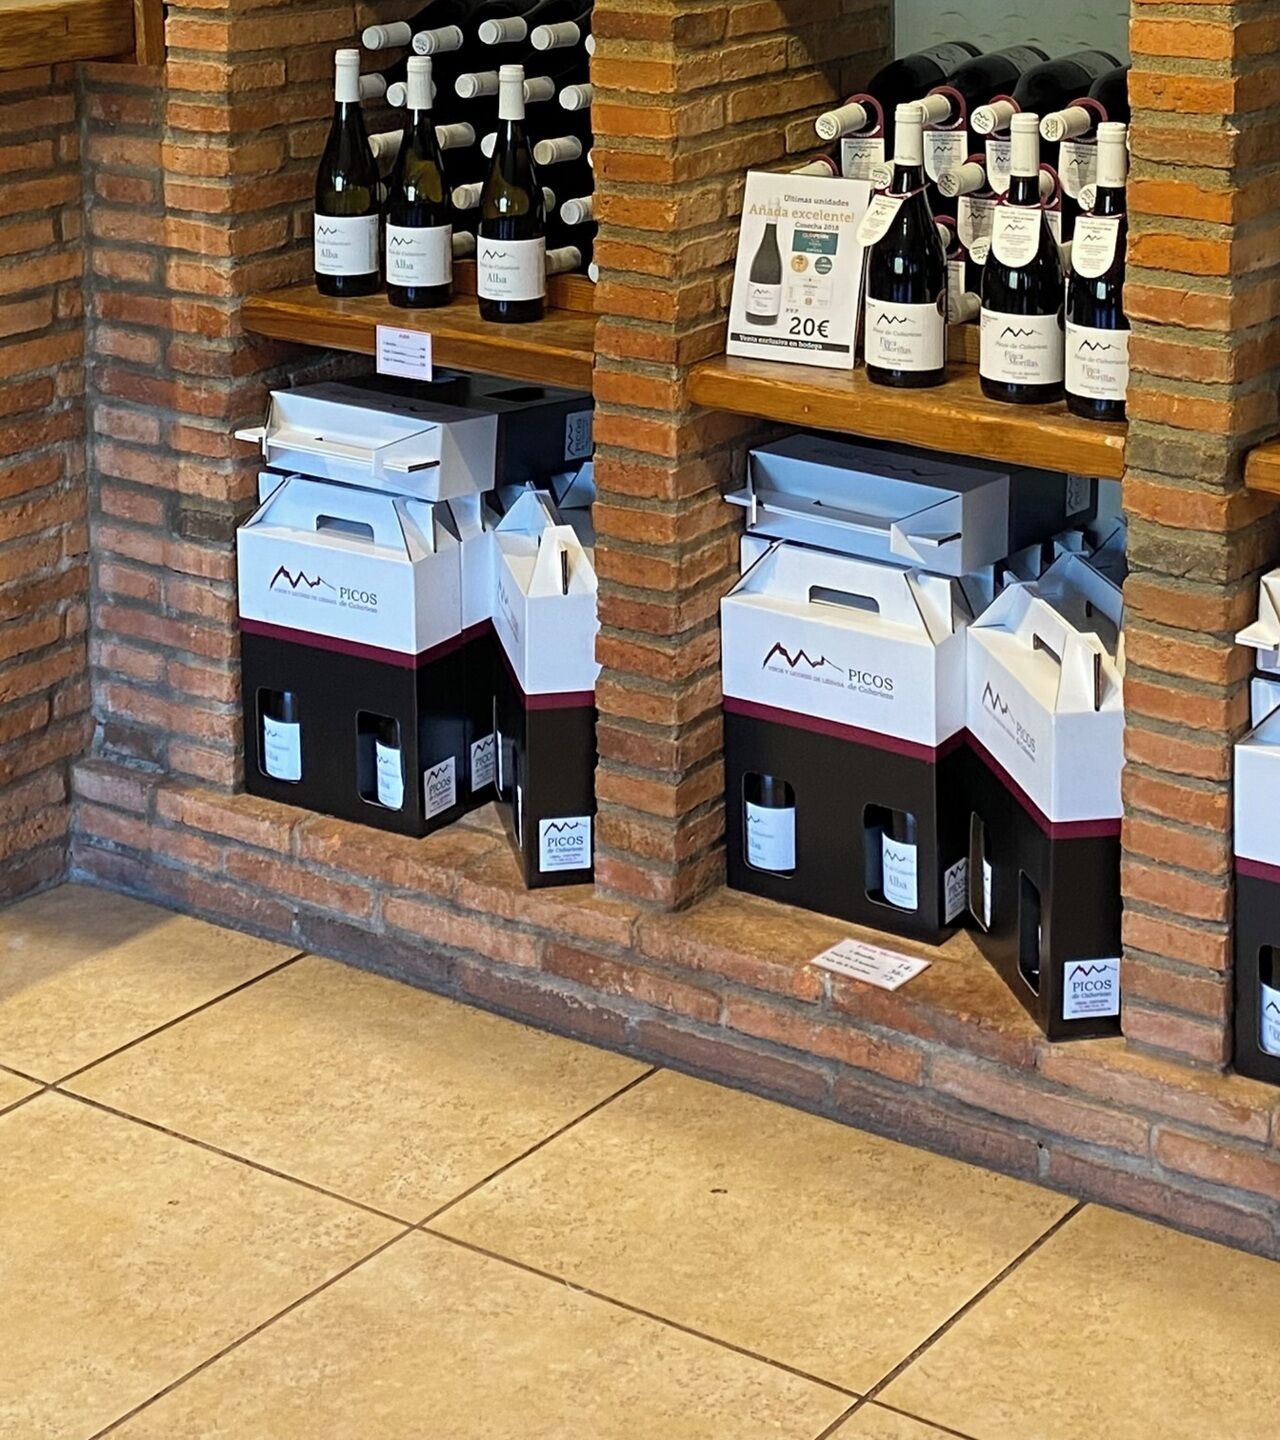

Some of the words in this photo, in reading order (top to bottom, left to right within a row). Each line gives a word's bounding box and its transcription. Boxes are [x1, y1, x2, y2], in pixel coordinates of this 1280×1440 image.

[749, 203, 788, 218] Añada
[792, 209, 855, 223] excelente!
[795, 222, 822, 230] Cosecha
[320, 248, 339, 260] Alba
[394, 259, 414, 271] Alba
[487, 272, 507, 284] Alba
[789, 316, 830, 338] 20€
[739, 334, 758, 343] Venta
[759, 337, 788, 347] exclusiva
[798, 341, 822, 351] bodega
[339, 586, 378, 606] PICOS
[848, 668, 894, 691] PICOS
[429, 774, 452, 794] PICOS
[547, 835, 584, 848] PICOS
[1072, 979, 1112, 992] PICOS
